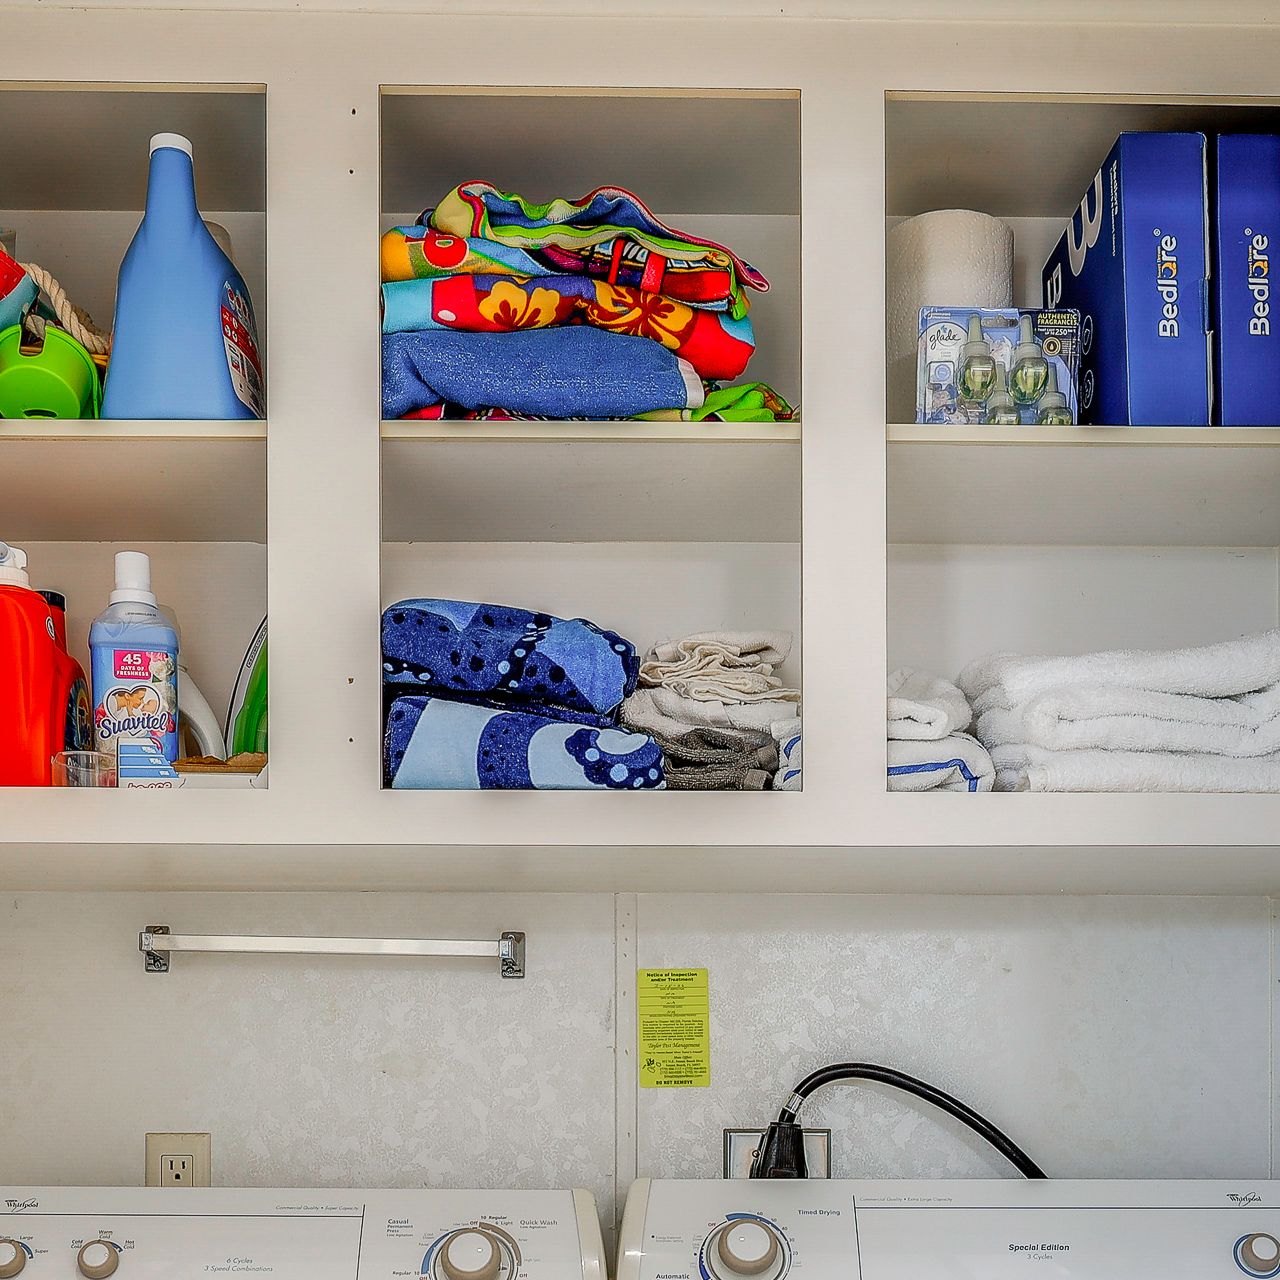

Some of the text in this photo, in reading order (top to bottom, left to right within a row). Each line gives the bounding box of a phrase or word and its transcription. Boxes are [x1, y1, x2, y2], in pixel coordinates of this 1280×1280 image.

[123, 654, 141, 664] 45
[100, 713, 167, 738] Suavitel
[5, 1198, 38, 1212] Whirlpool
[1009, 1244, 1038, 1252] Special
